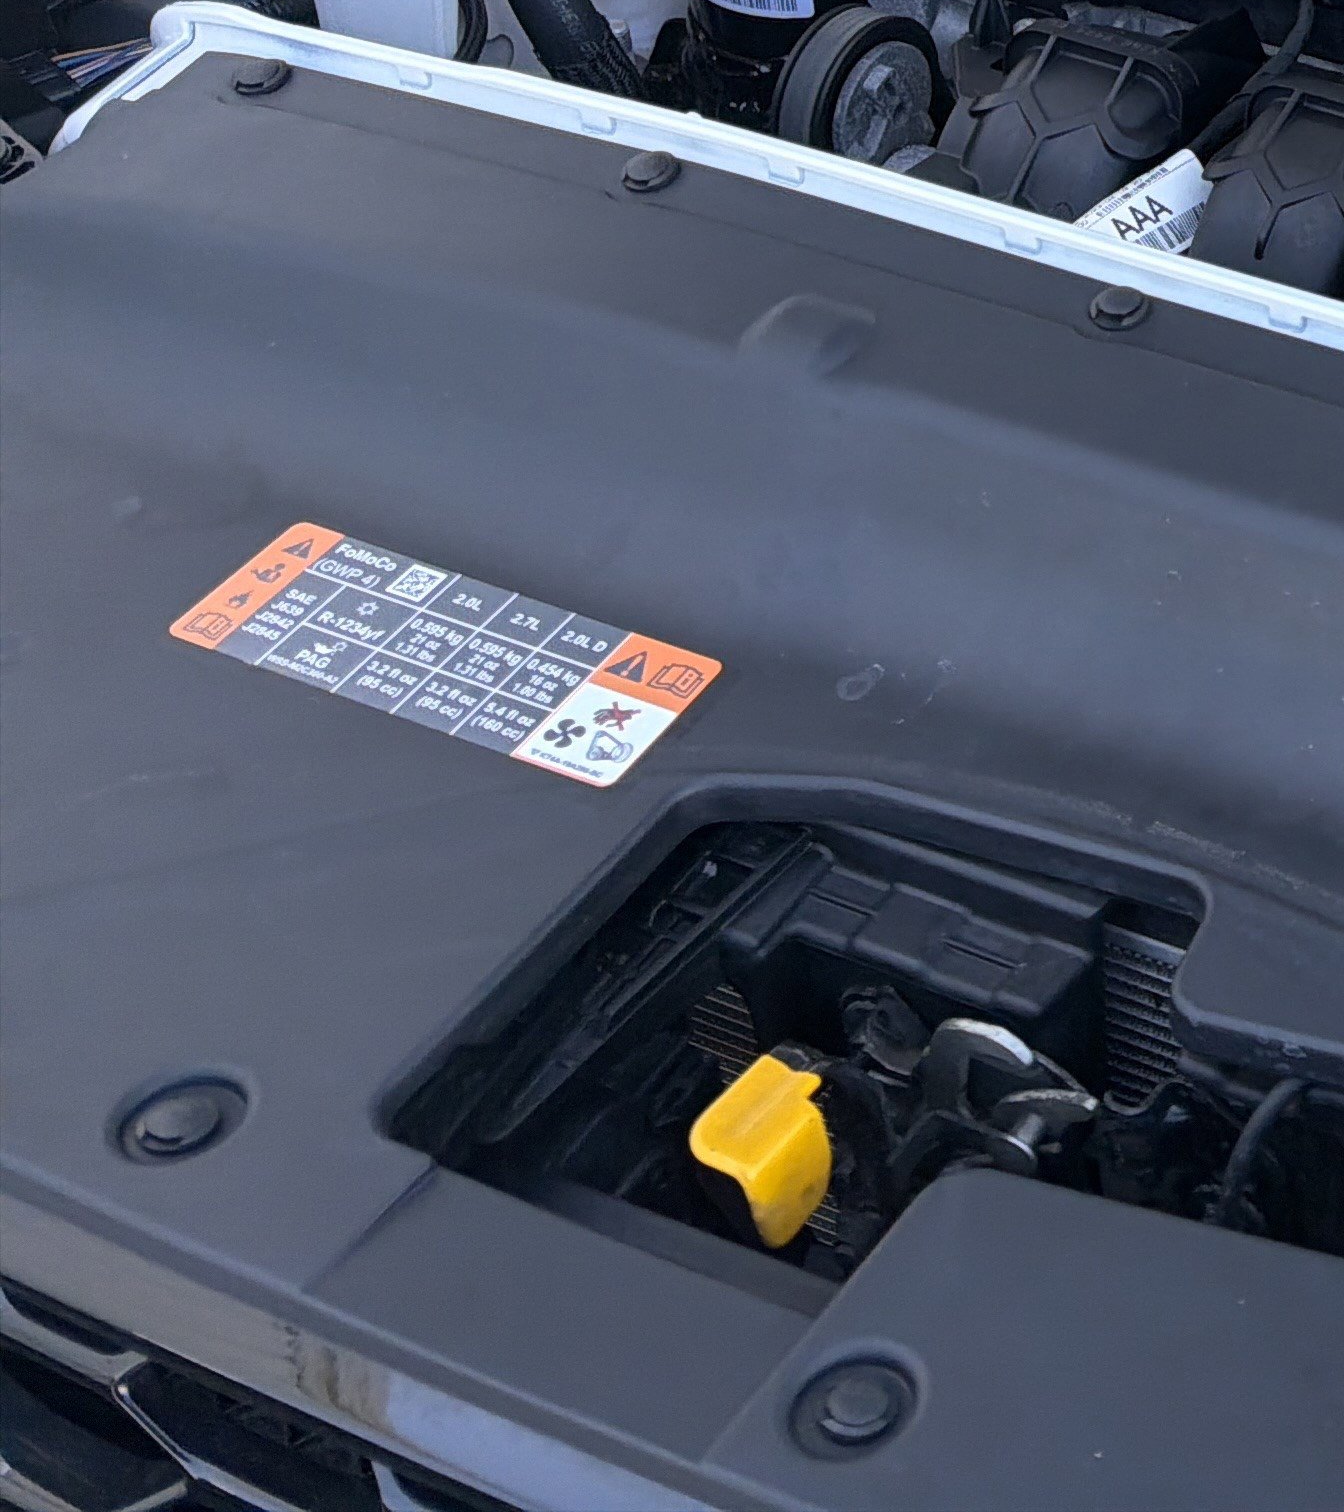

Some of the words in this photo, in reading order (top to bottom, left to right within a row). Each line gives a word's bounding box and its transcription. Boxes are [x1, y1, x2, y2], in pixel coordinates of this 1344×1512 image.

[1111, 196, 1172, 239] AAA
[335, 543, 397, 571] FoMoCo
[312, 558, 363, 579] (GWP
[285, 589, 317, 605] SAE
[452, 593, 482, 611] 2.0L
[317, 611, 385, 640] R-1234yf
[410, 618, 447, 637] 0.595
[510, 613, 540, 631] 2.7L
[468, 638, 506, 658] 0.595
[560, 630, 591, 649] 2.0L
[294, 649, 331, 669] PAG
[526, 658, 564, 678] 0.454
